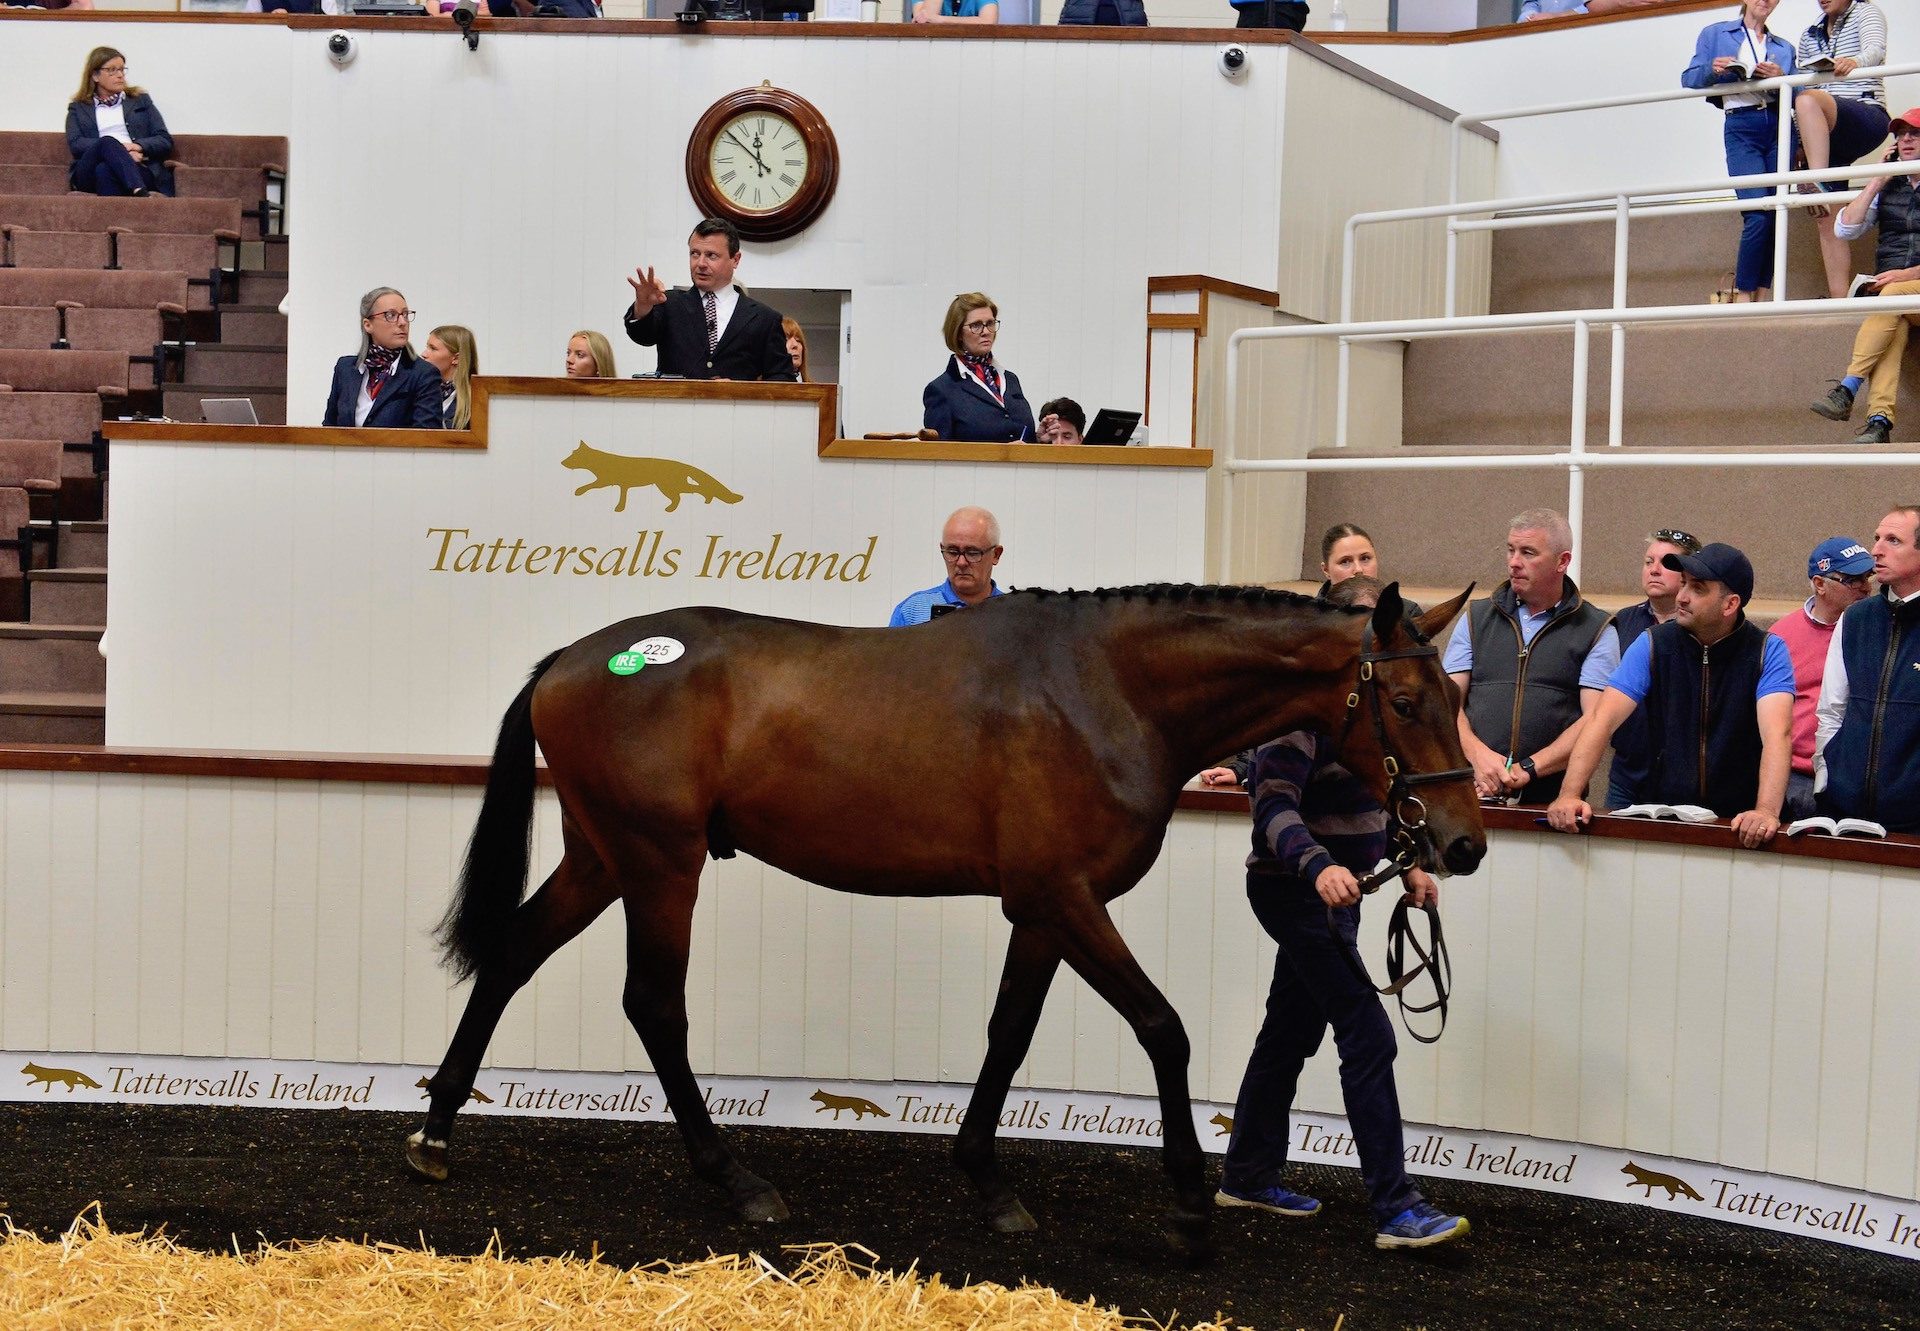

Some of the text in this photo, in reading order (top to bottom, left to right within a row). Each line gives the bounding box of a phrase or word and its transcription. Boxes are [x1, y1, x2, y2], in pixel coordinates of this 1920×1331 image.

[426, 527, 879, 583] Tattersalls Ireland
[615, 654, 639, 667] IRE
[642, 643, 671, 656] 225
[107, 1066, 375, 1104] Tattersalls Ireland
[499, 1081, 653, 1113] Tattersalls
[896, 1094, 1050, 1131] Tattealls
[1296, 1123, 1578, 1184] Tattalls Ireland
[1710, 1178, 1879, 1239] Tattersalls
